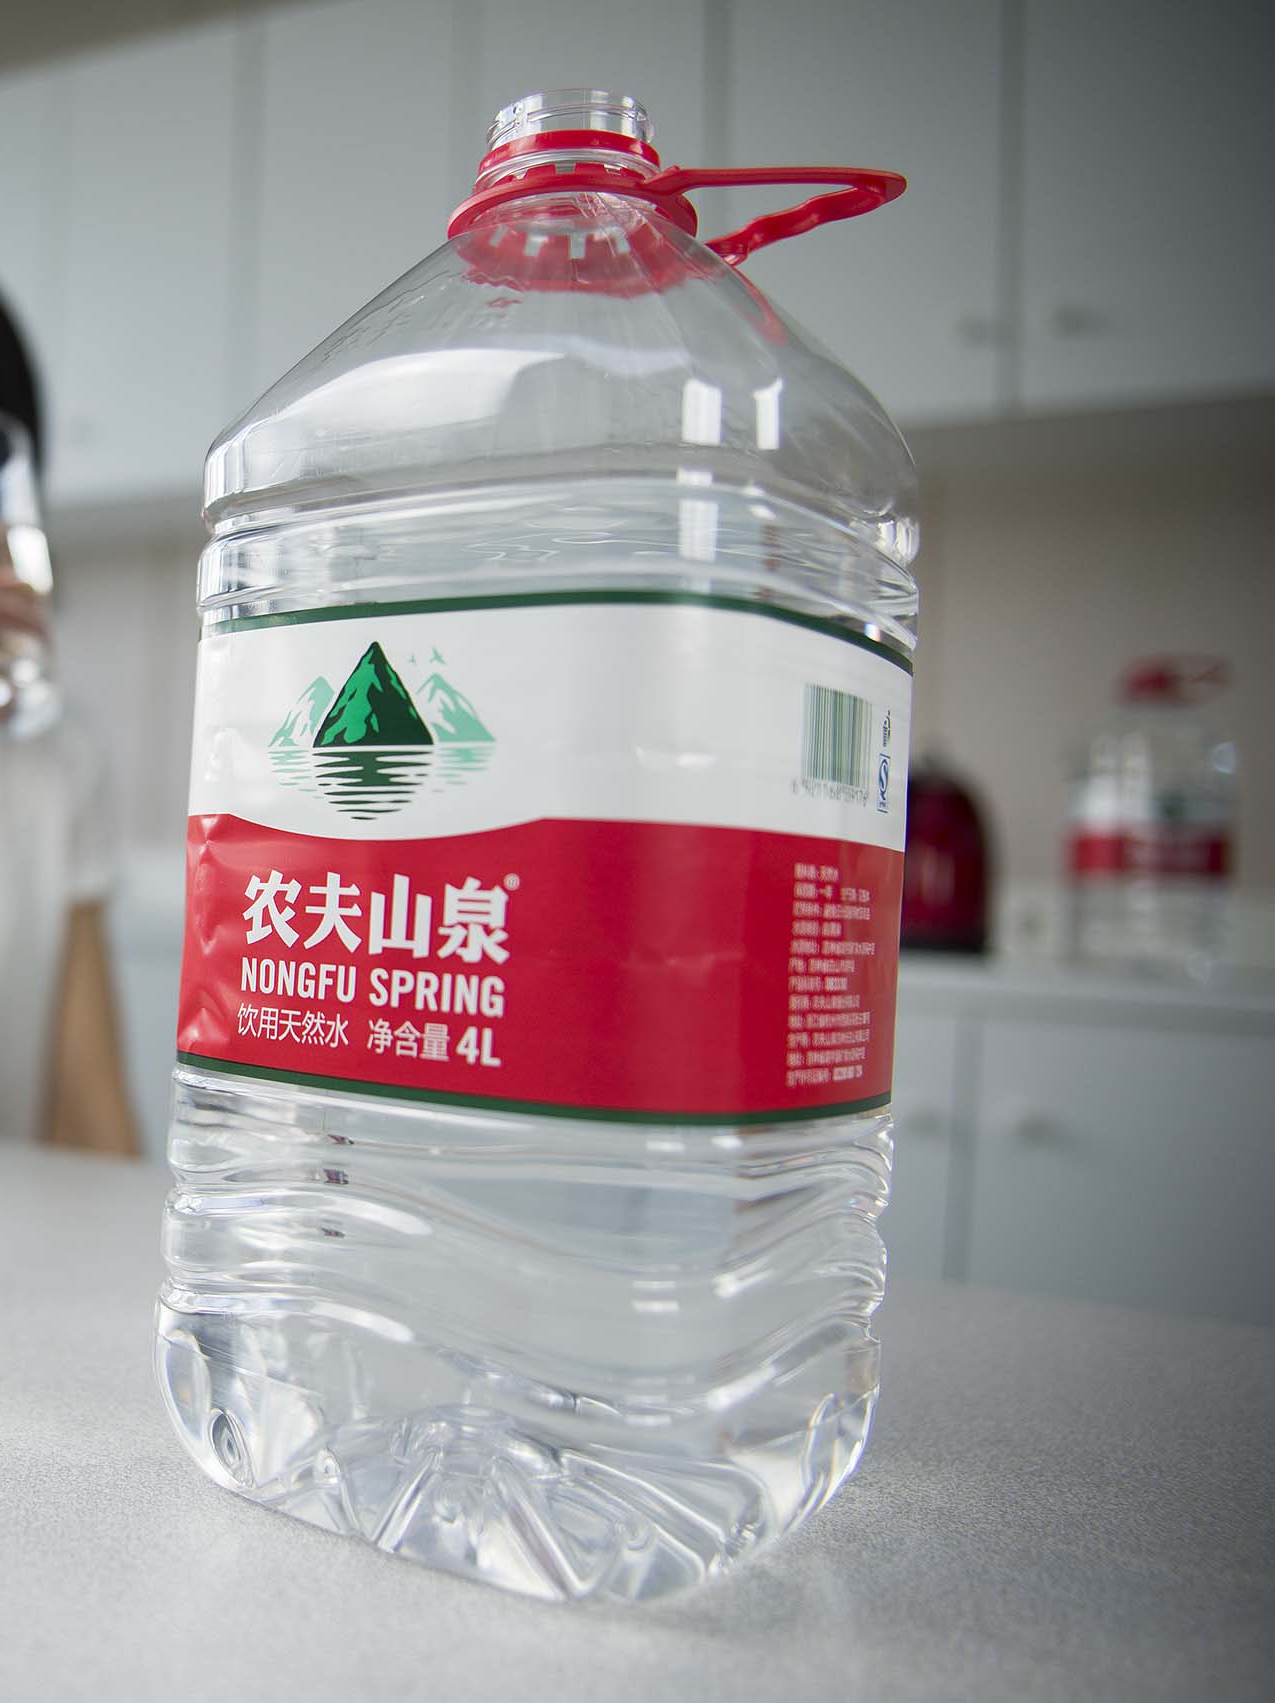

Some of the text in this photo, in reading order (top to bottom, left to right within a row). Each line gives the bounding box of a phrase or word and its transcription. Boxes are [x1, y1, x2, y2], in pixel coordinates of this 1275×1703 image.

[242, 868, 510, 964] 农夫山泉
[240, 956, 505, 1017] NONGFU SPRING
[237, 1001, 502, 1068] 饮用天然水 净含量 4L
